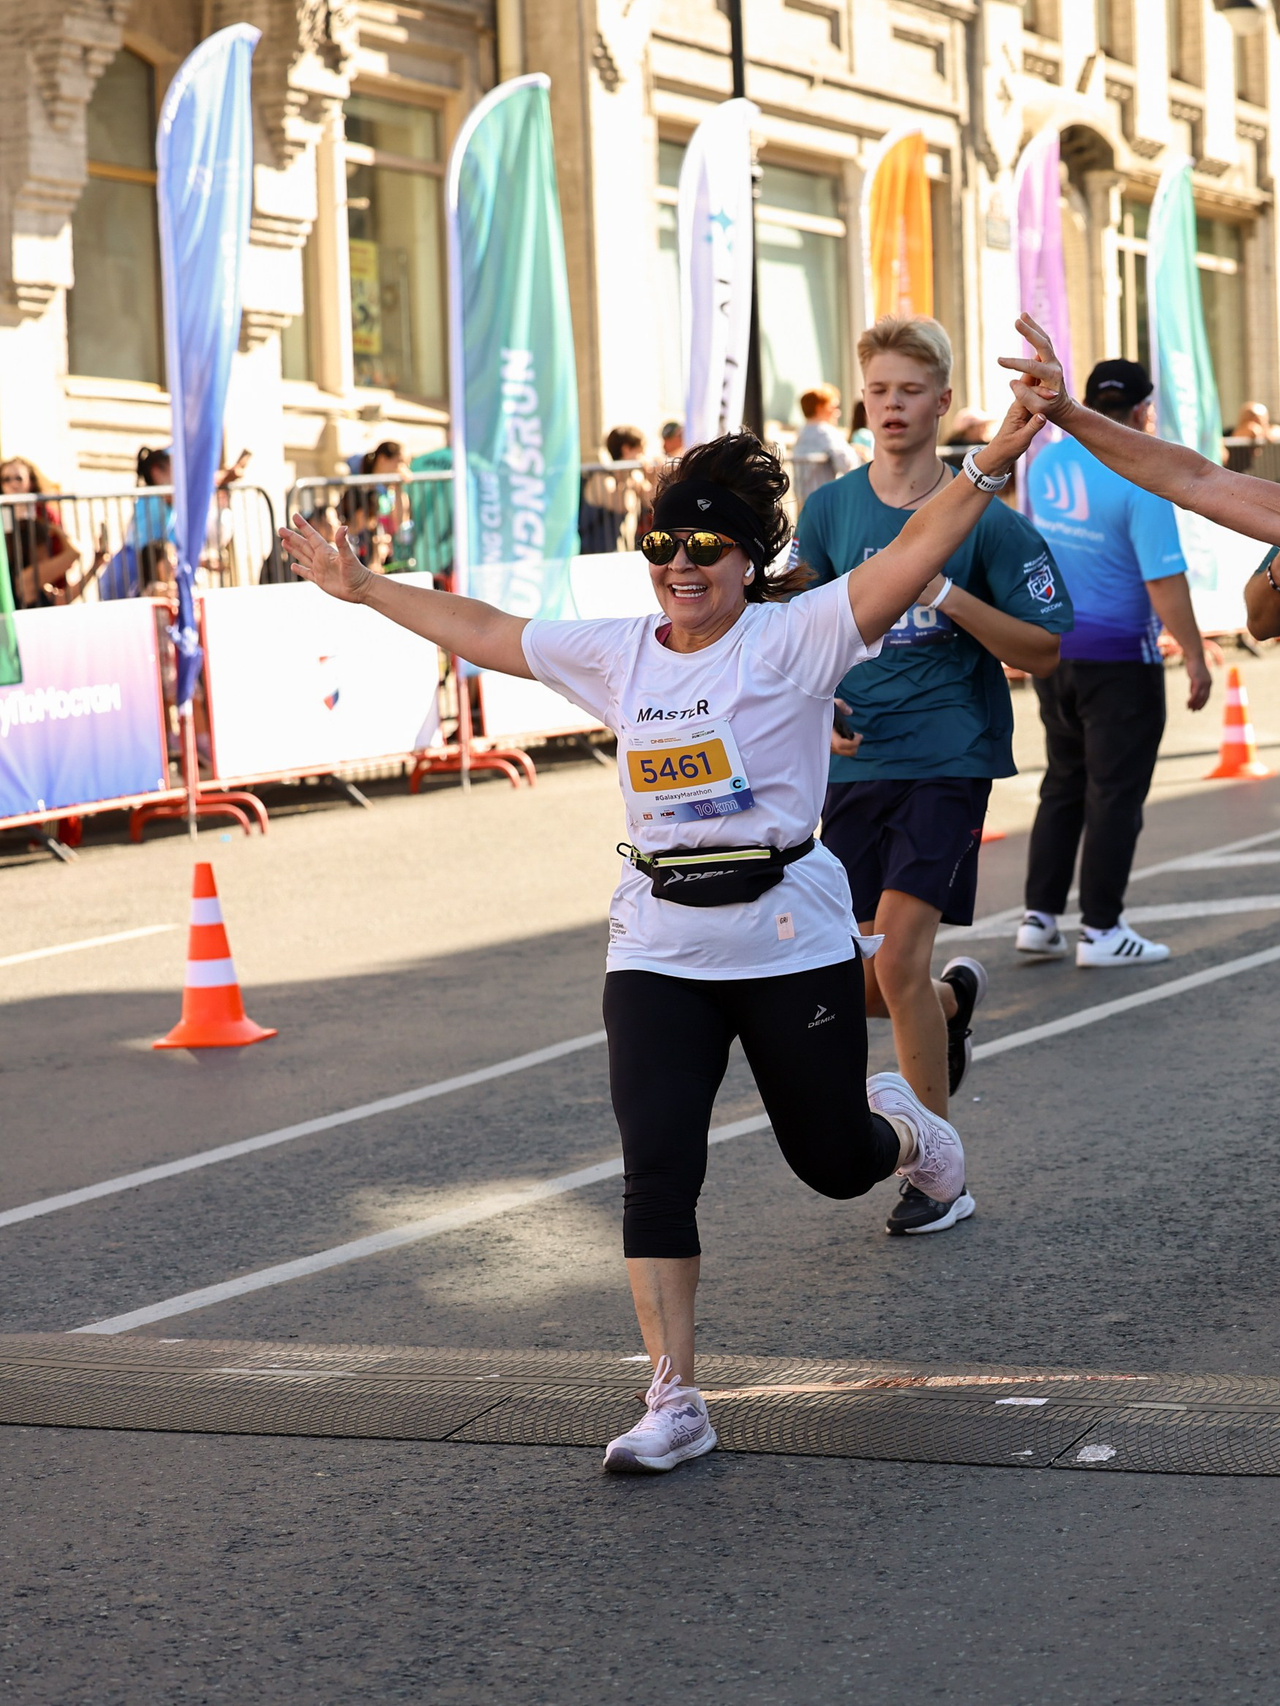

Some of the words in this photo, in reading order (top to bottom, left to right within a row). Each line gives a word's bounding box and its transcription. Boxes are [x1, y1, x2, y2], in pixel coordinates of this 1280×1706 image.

[640, 751, 712, 784] 5461
[732, 779, 742, 789] C
[655, 787, 713, 801] #GalaxyMarathon
[694, 799, 740, 816] 10km
[807, 1014, 836, 1029] DEMIX
